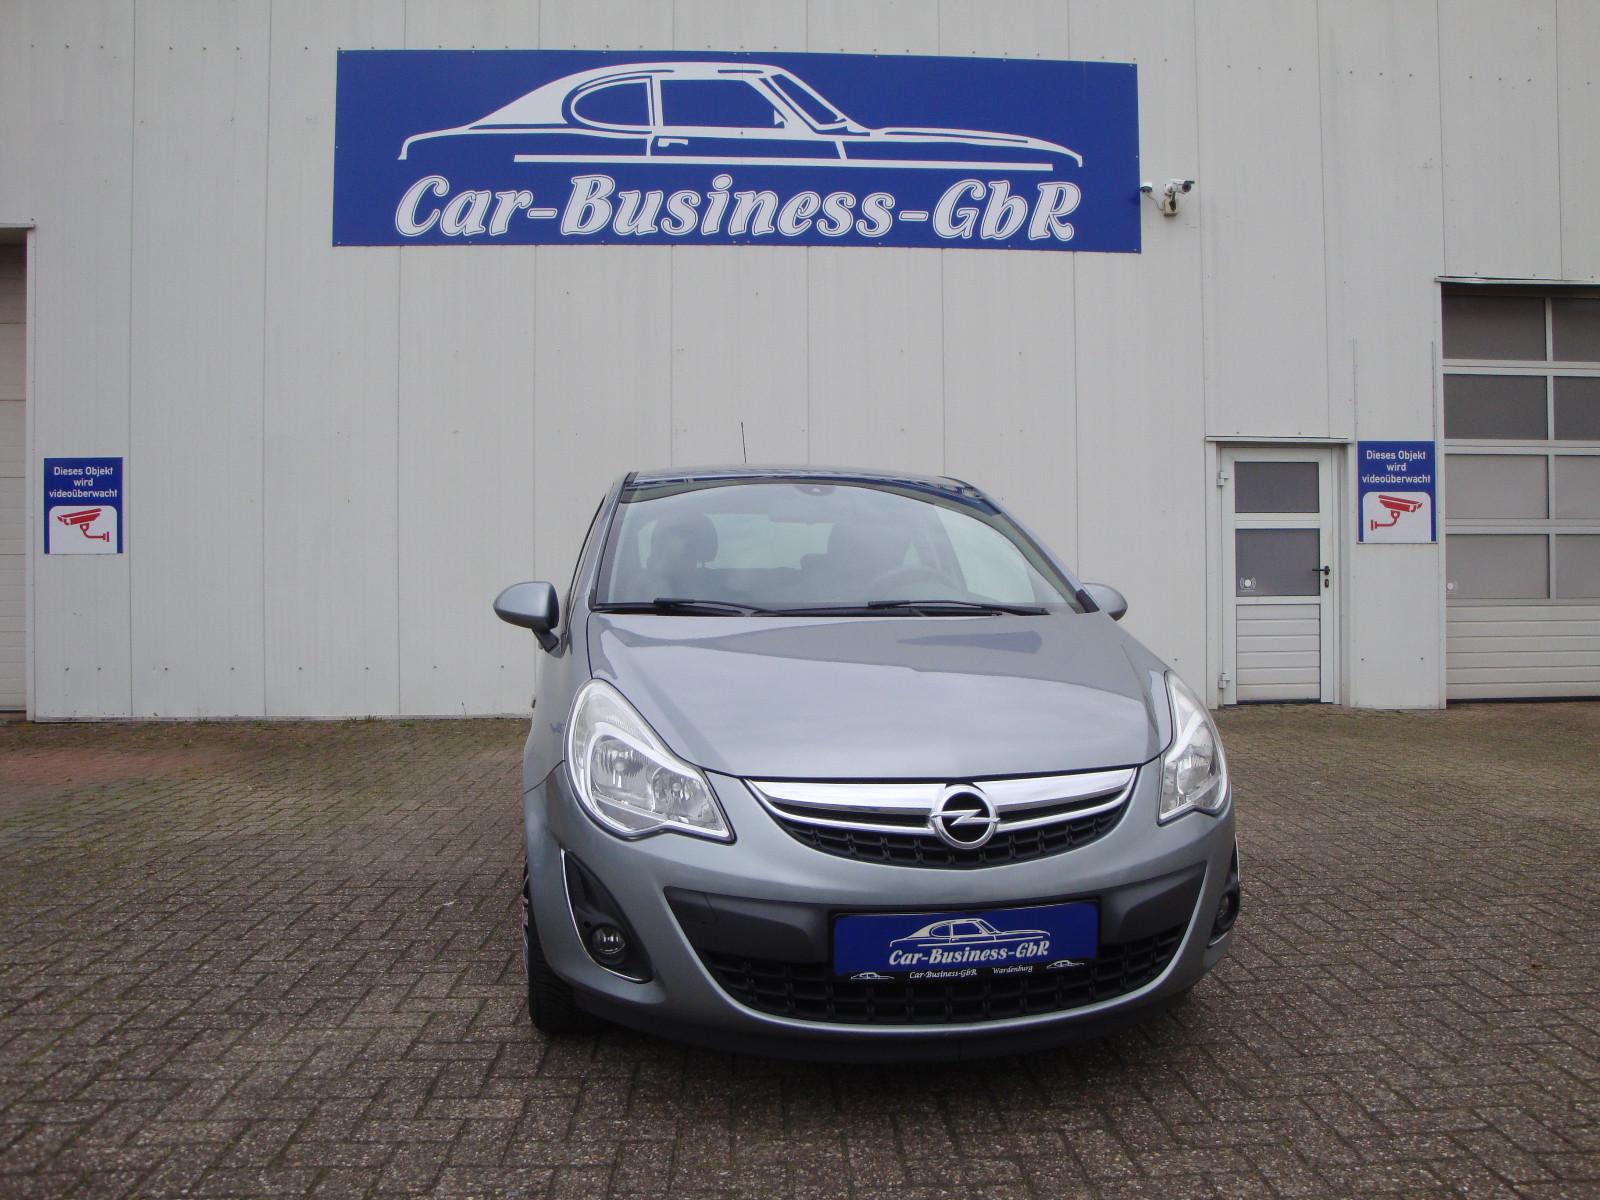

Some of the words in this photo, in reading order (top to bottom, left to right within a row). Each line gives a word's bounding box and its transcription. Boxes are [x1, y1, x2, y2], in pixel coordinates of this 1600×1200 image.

[394, 173, 1082, 243] Car-Business-GbR
[1366, 450, 1396, 460] Dieses
[1398, 450, 1426, 461] Objekt
[53, 466, 83, 476] Dieses
[85, 466, 113, 477] Objekt
[1386, 462, 1407, 472] wird
[73, 478, 94, 487] wird
[1362, 474, 1431, 484] videoüberwacht
[49, 488, 118, 498] videoüberwacht
[889, 941, 1049, 965] Car-Business-GbR
